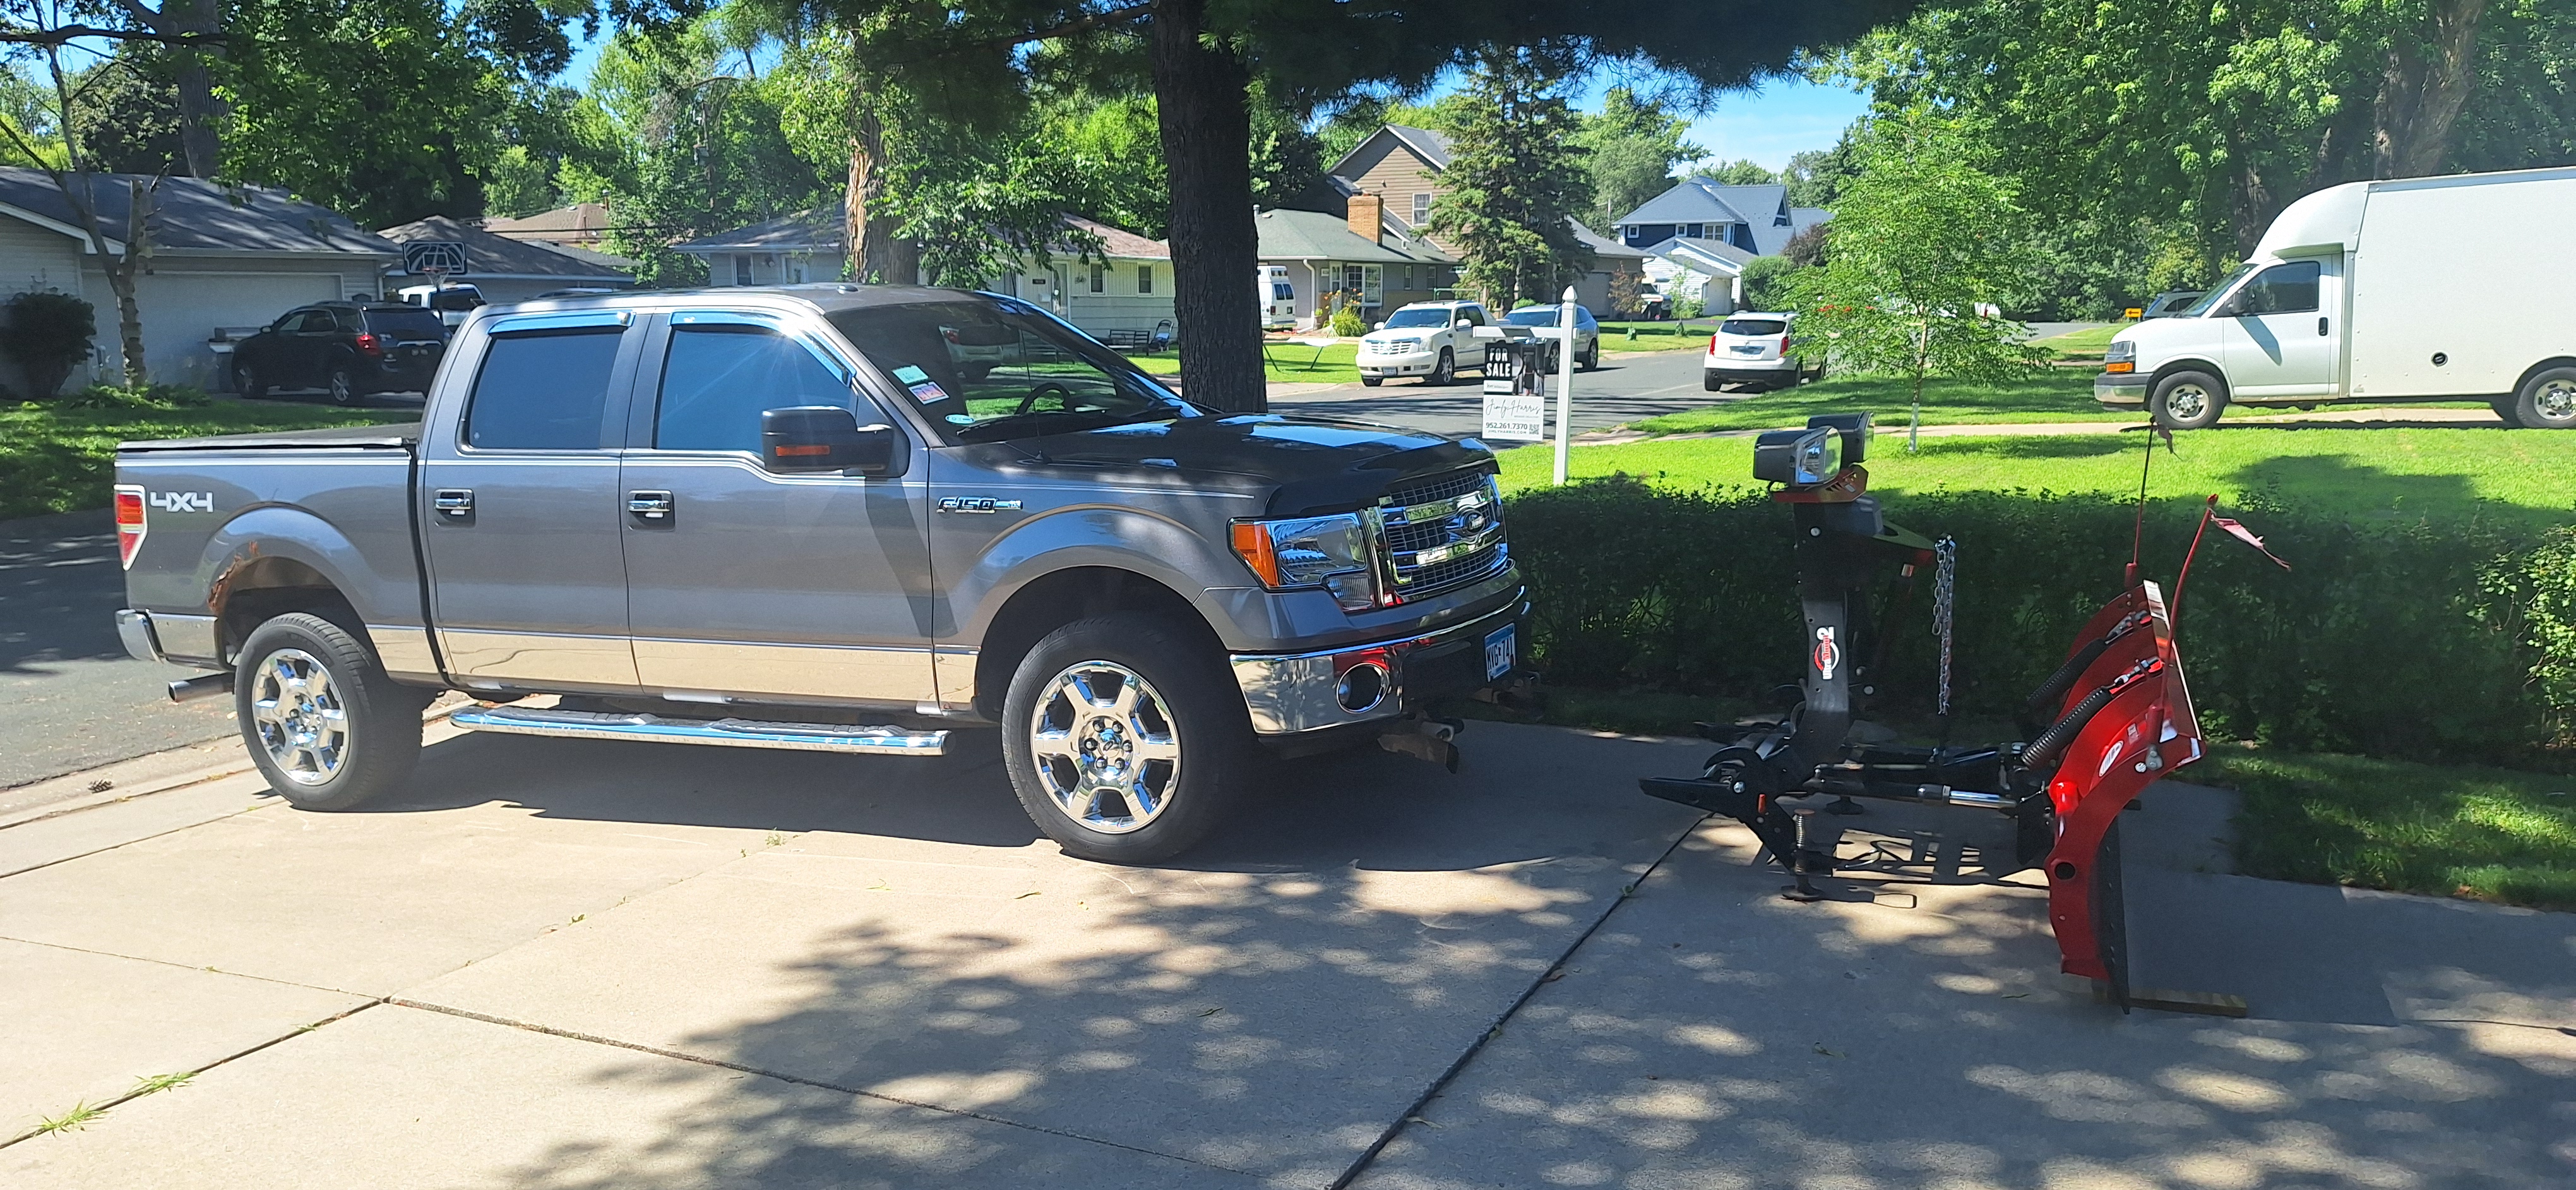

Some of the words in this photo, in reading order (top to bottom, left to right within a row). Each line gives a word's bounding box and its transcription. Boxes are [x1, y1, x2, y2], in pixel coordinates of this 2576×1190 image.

[1489, 348, 1508, 361] FOR
[1486, 363, 1510, 377] SALE
[1507, 399, 1541, 416] Harris
